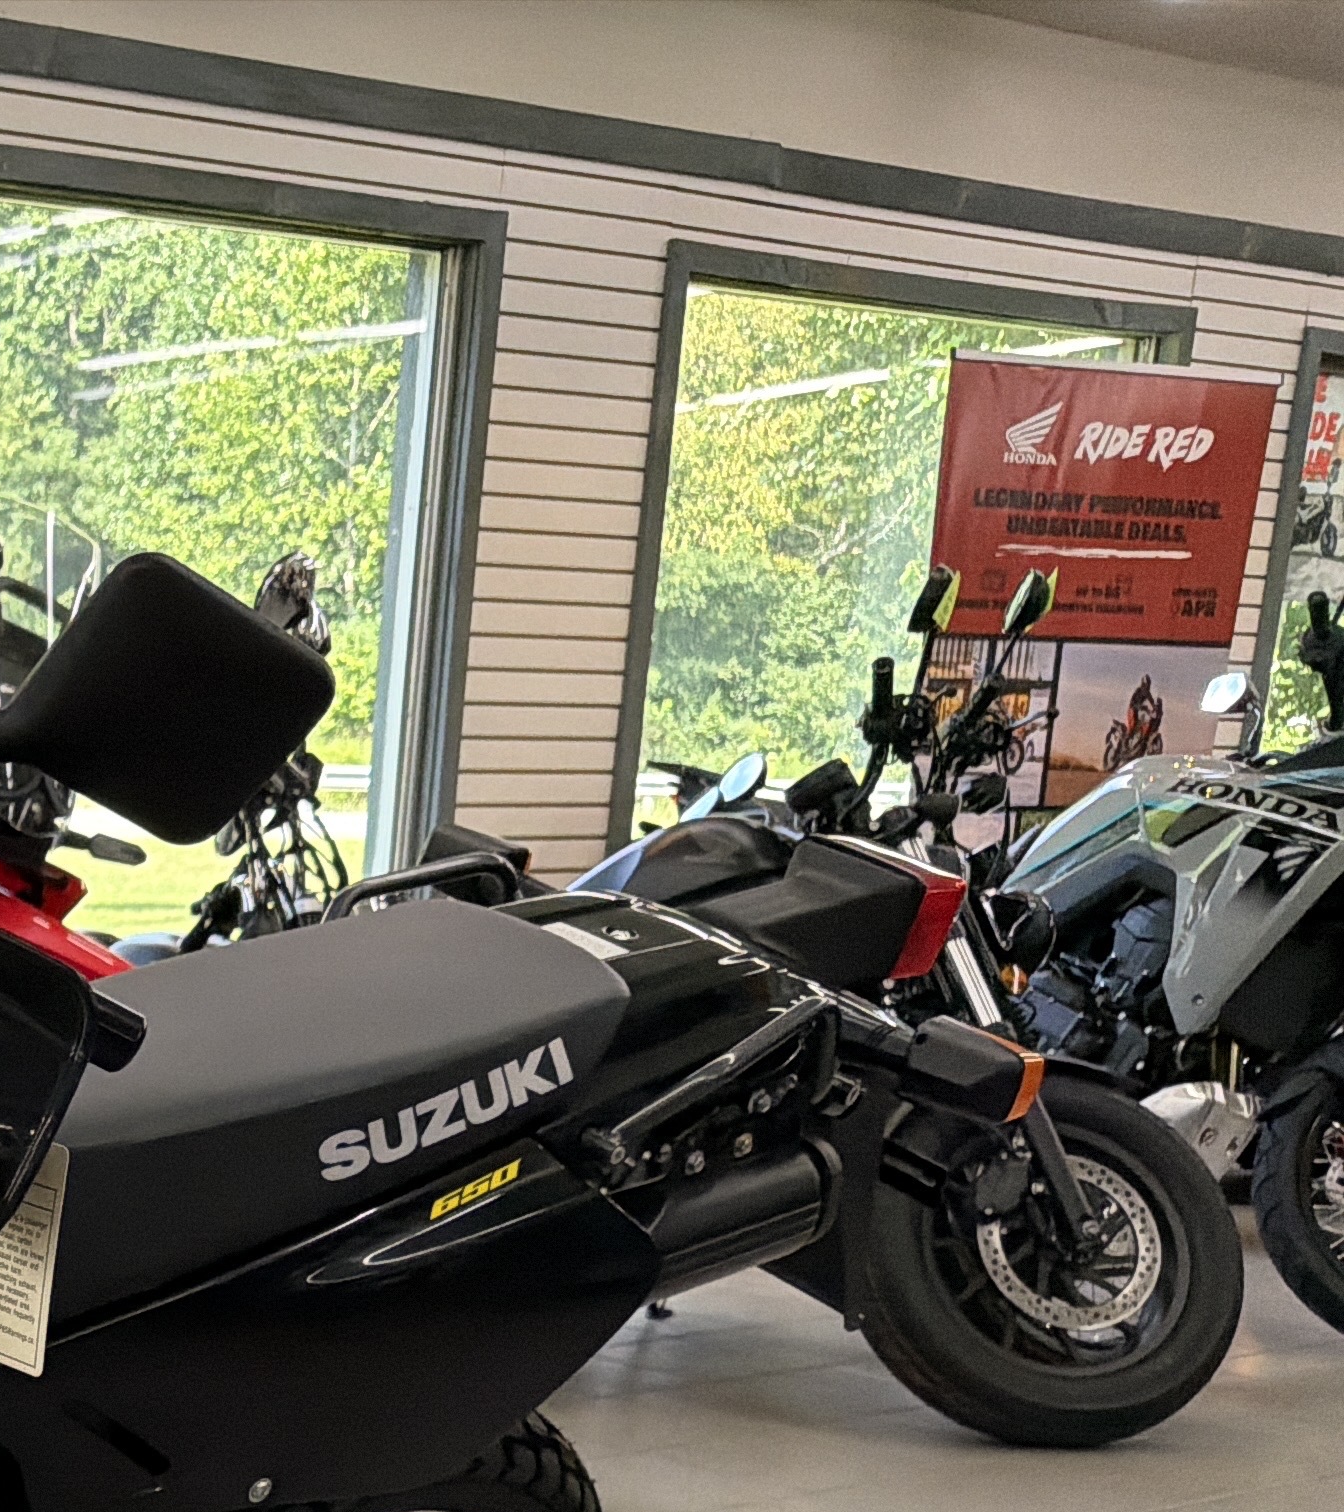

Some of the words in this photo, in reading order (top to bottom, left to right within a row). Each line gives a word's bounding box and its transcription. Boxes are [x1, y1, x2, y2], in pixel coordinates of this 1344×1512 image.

[1002, 451, 1058, 466] HONDA
[1074, 421, 1152, 465] RIDE
[1147, 424, 1215, 472] RED
[1165, 777, 1340, 832] HONDA
[317, 1036, 575, 1182] SUZUKI
[429, 1158, 522, 1221] 650
